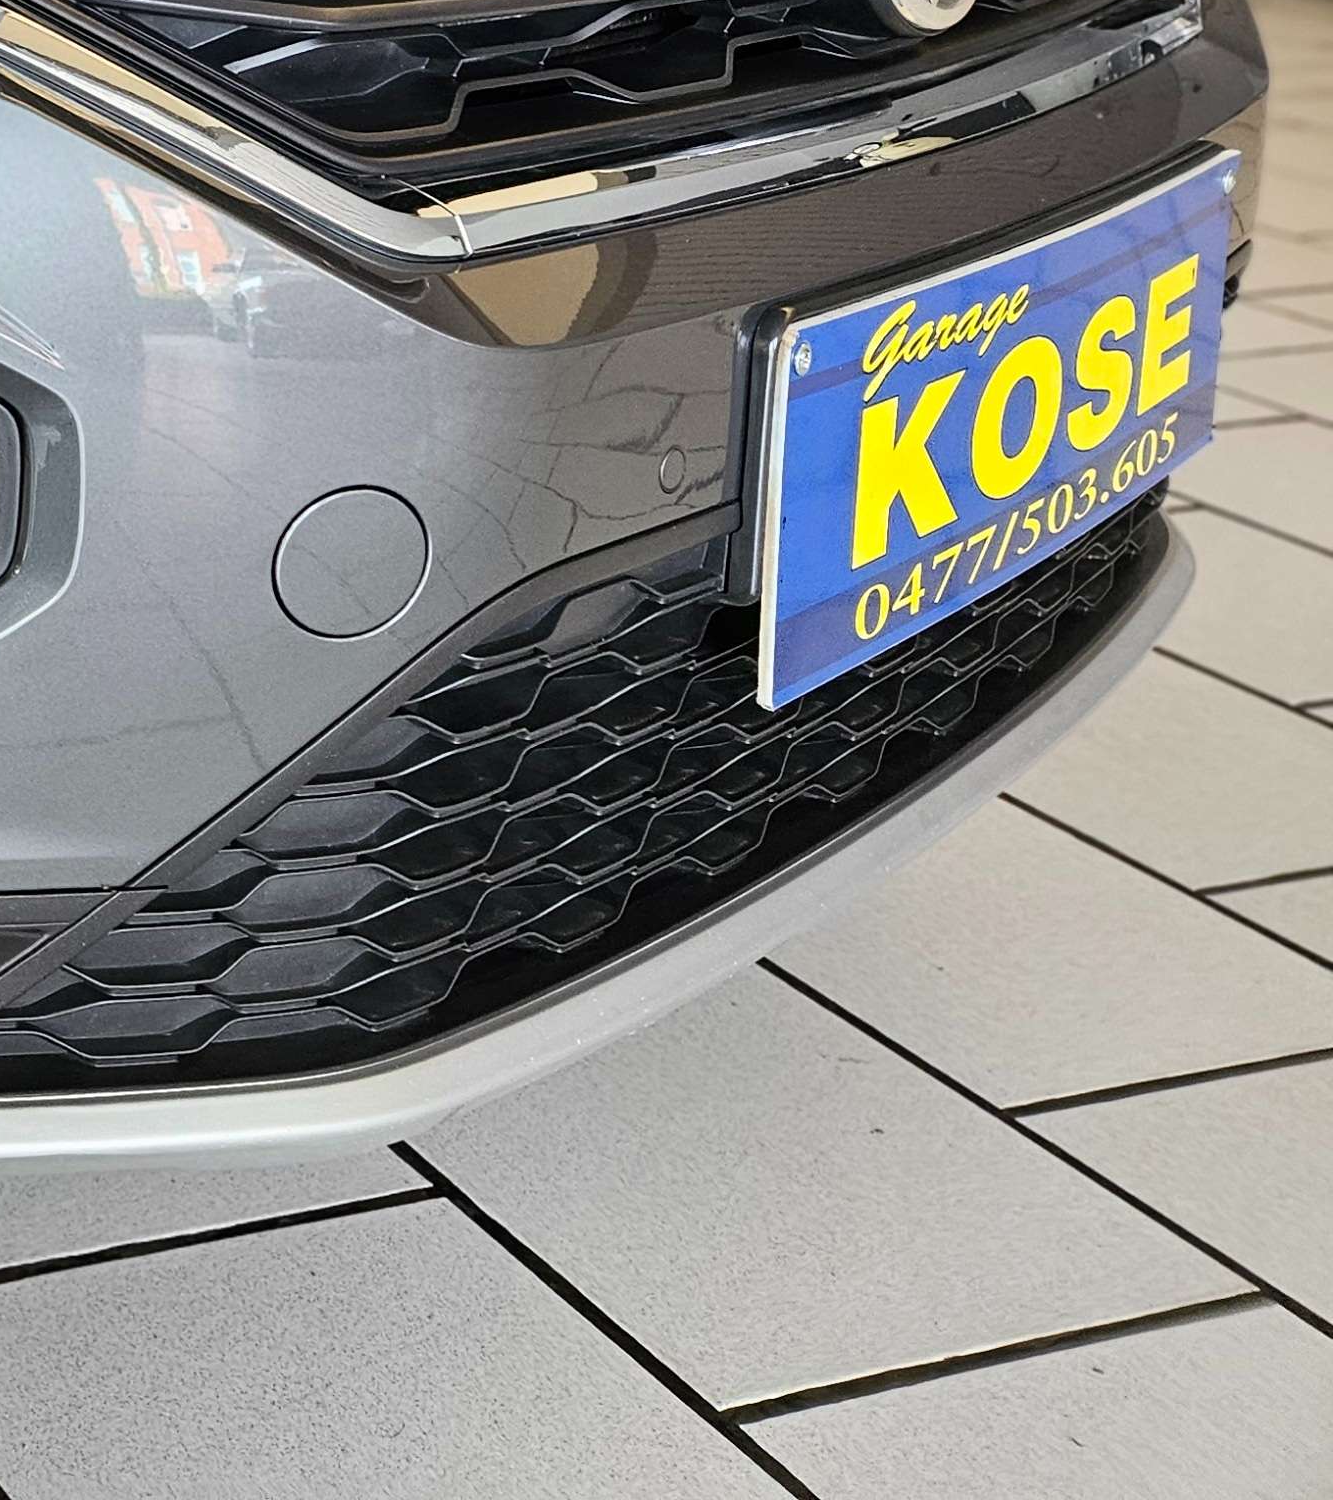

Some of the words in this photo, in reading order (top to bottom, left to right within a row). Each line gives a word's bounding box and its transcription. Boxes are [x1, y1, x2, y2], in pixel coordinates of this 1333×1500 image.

[851, 252, 1200, 569] KOSE
[861, 283, 1030, 402] Garage
[854, 411, 1180, 641] 0477/503.605
